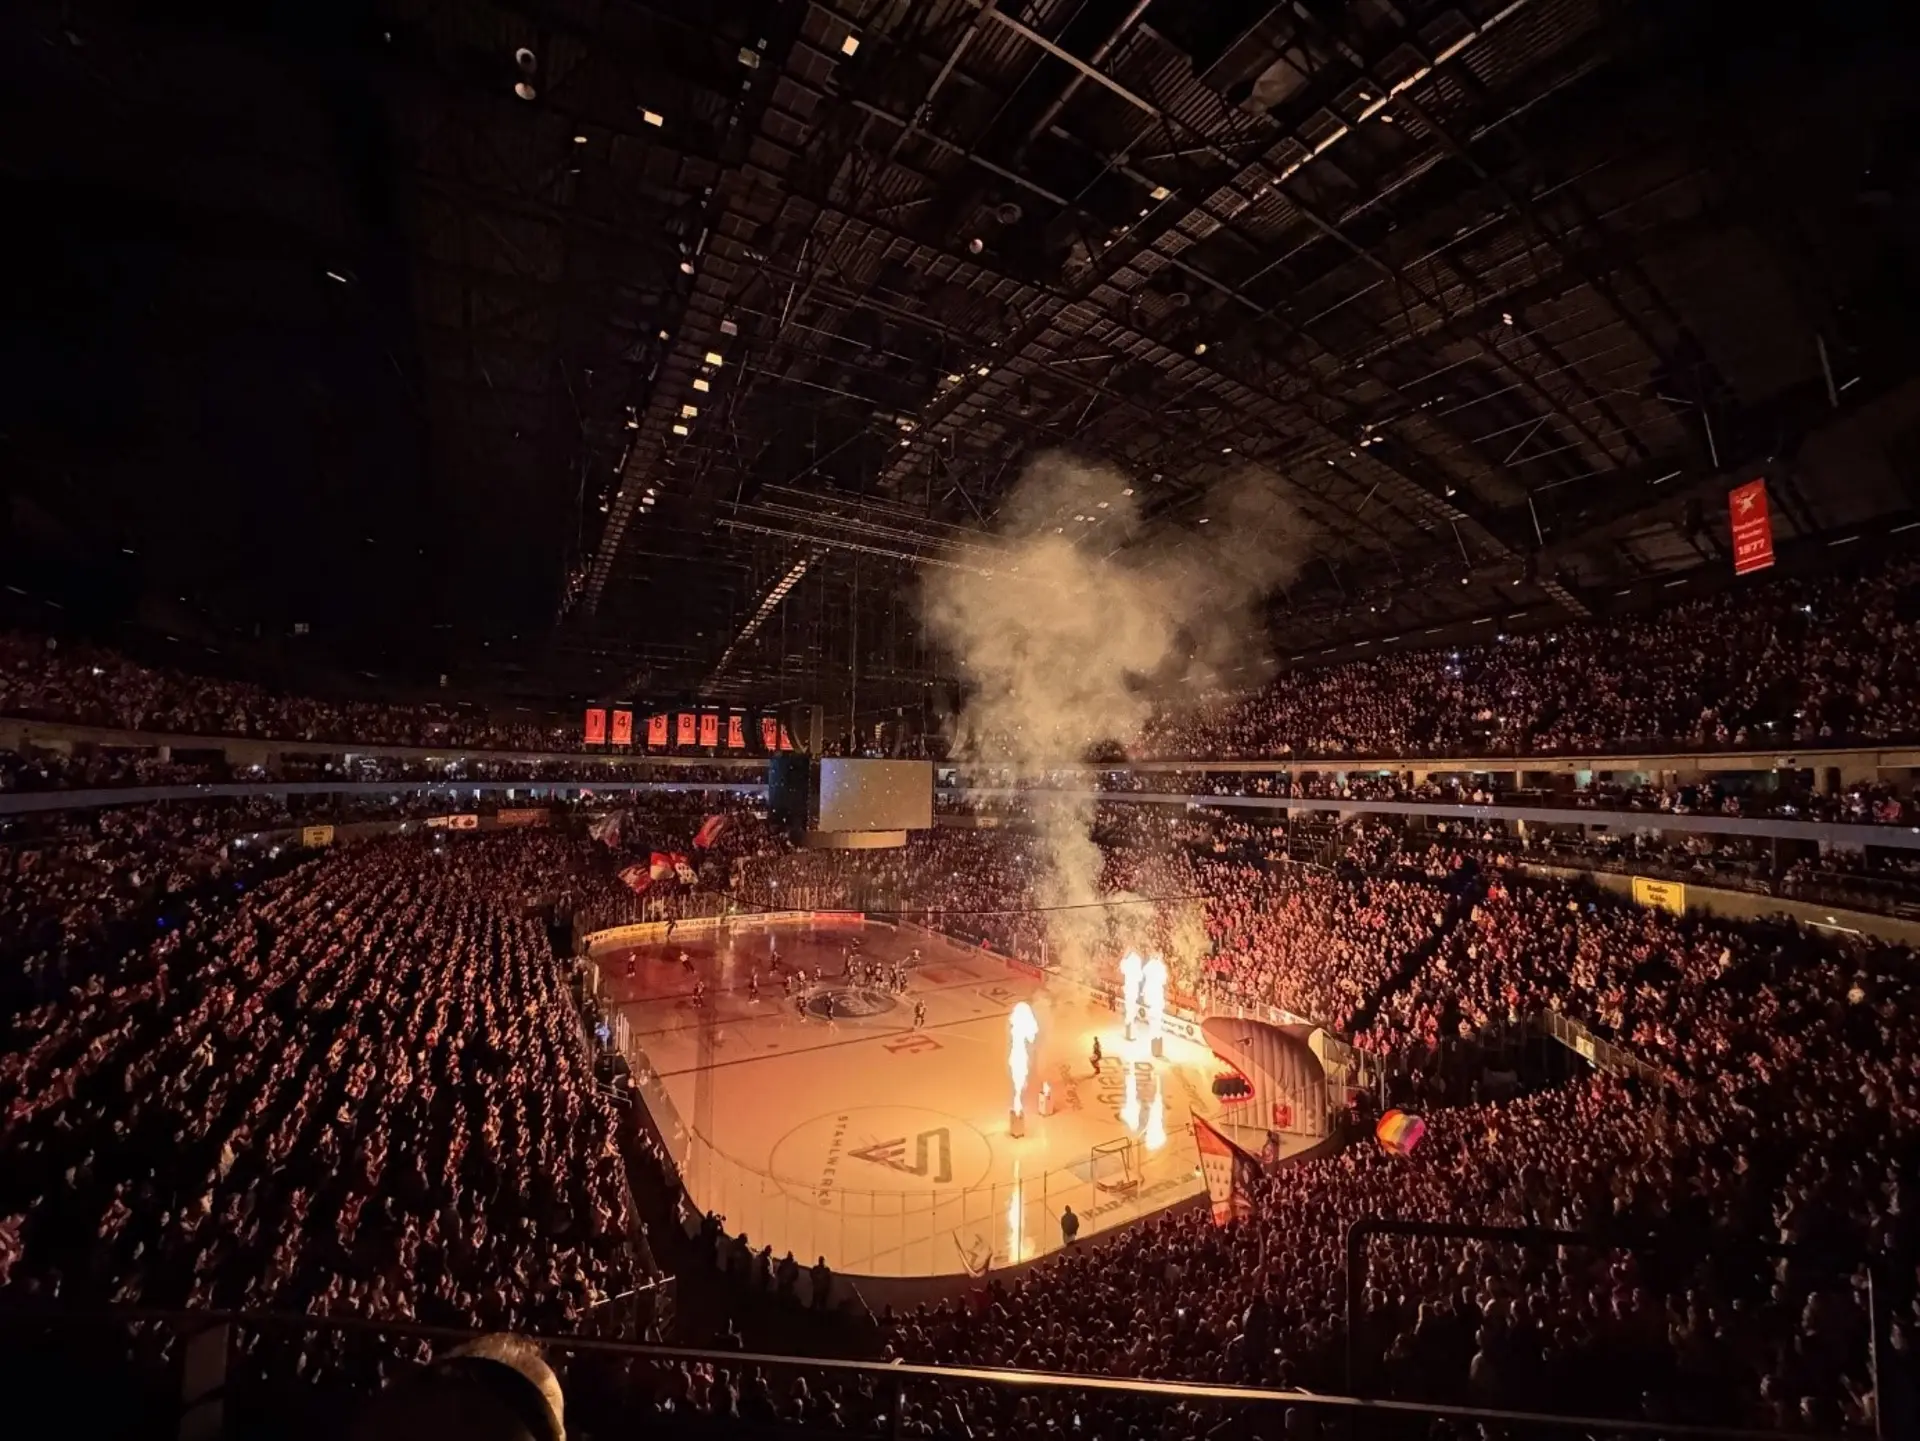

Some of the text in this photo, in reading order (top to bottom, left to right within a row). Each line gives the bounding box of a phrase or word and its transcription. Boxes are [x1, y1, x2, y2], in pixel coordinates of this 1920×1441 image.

[617, 715, 626, 727] 4
[654, 717, 662, 729] 6
[683, 716, 691, 728] 8
[705, 718, 715, 731] 11
